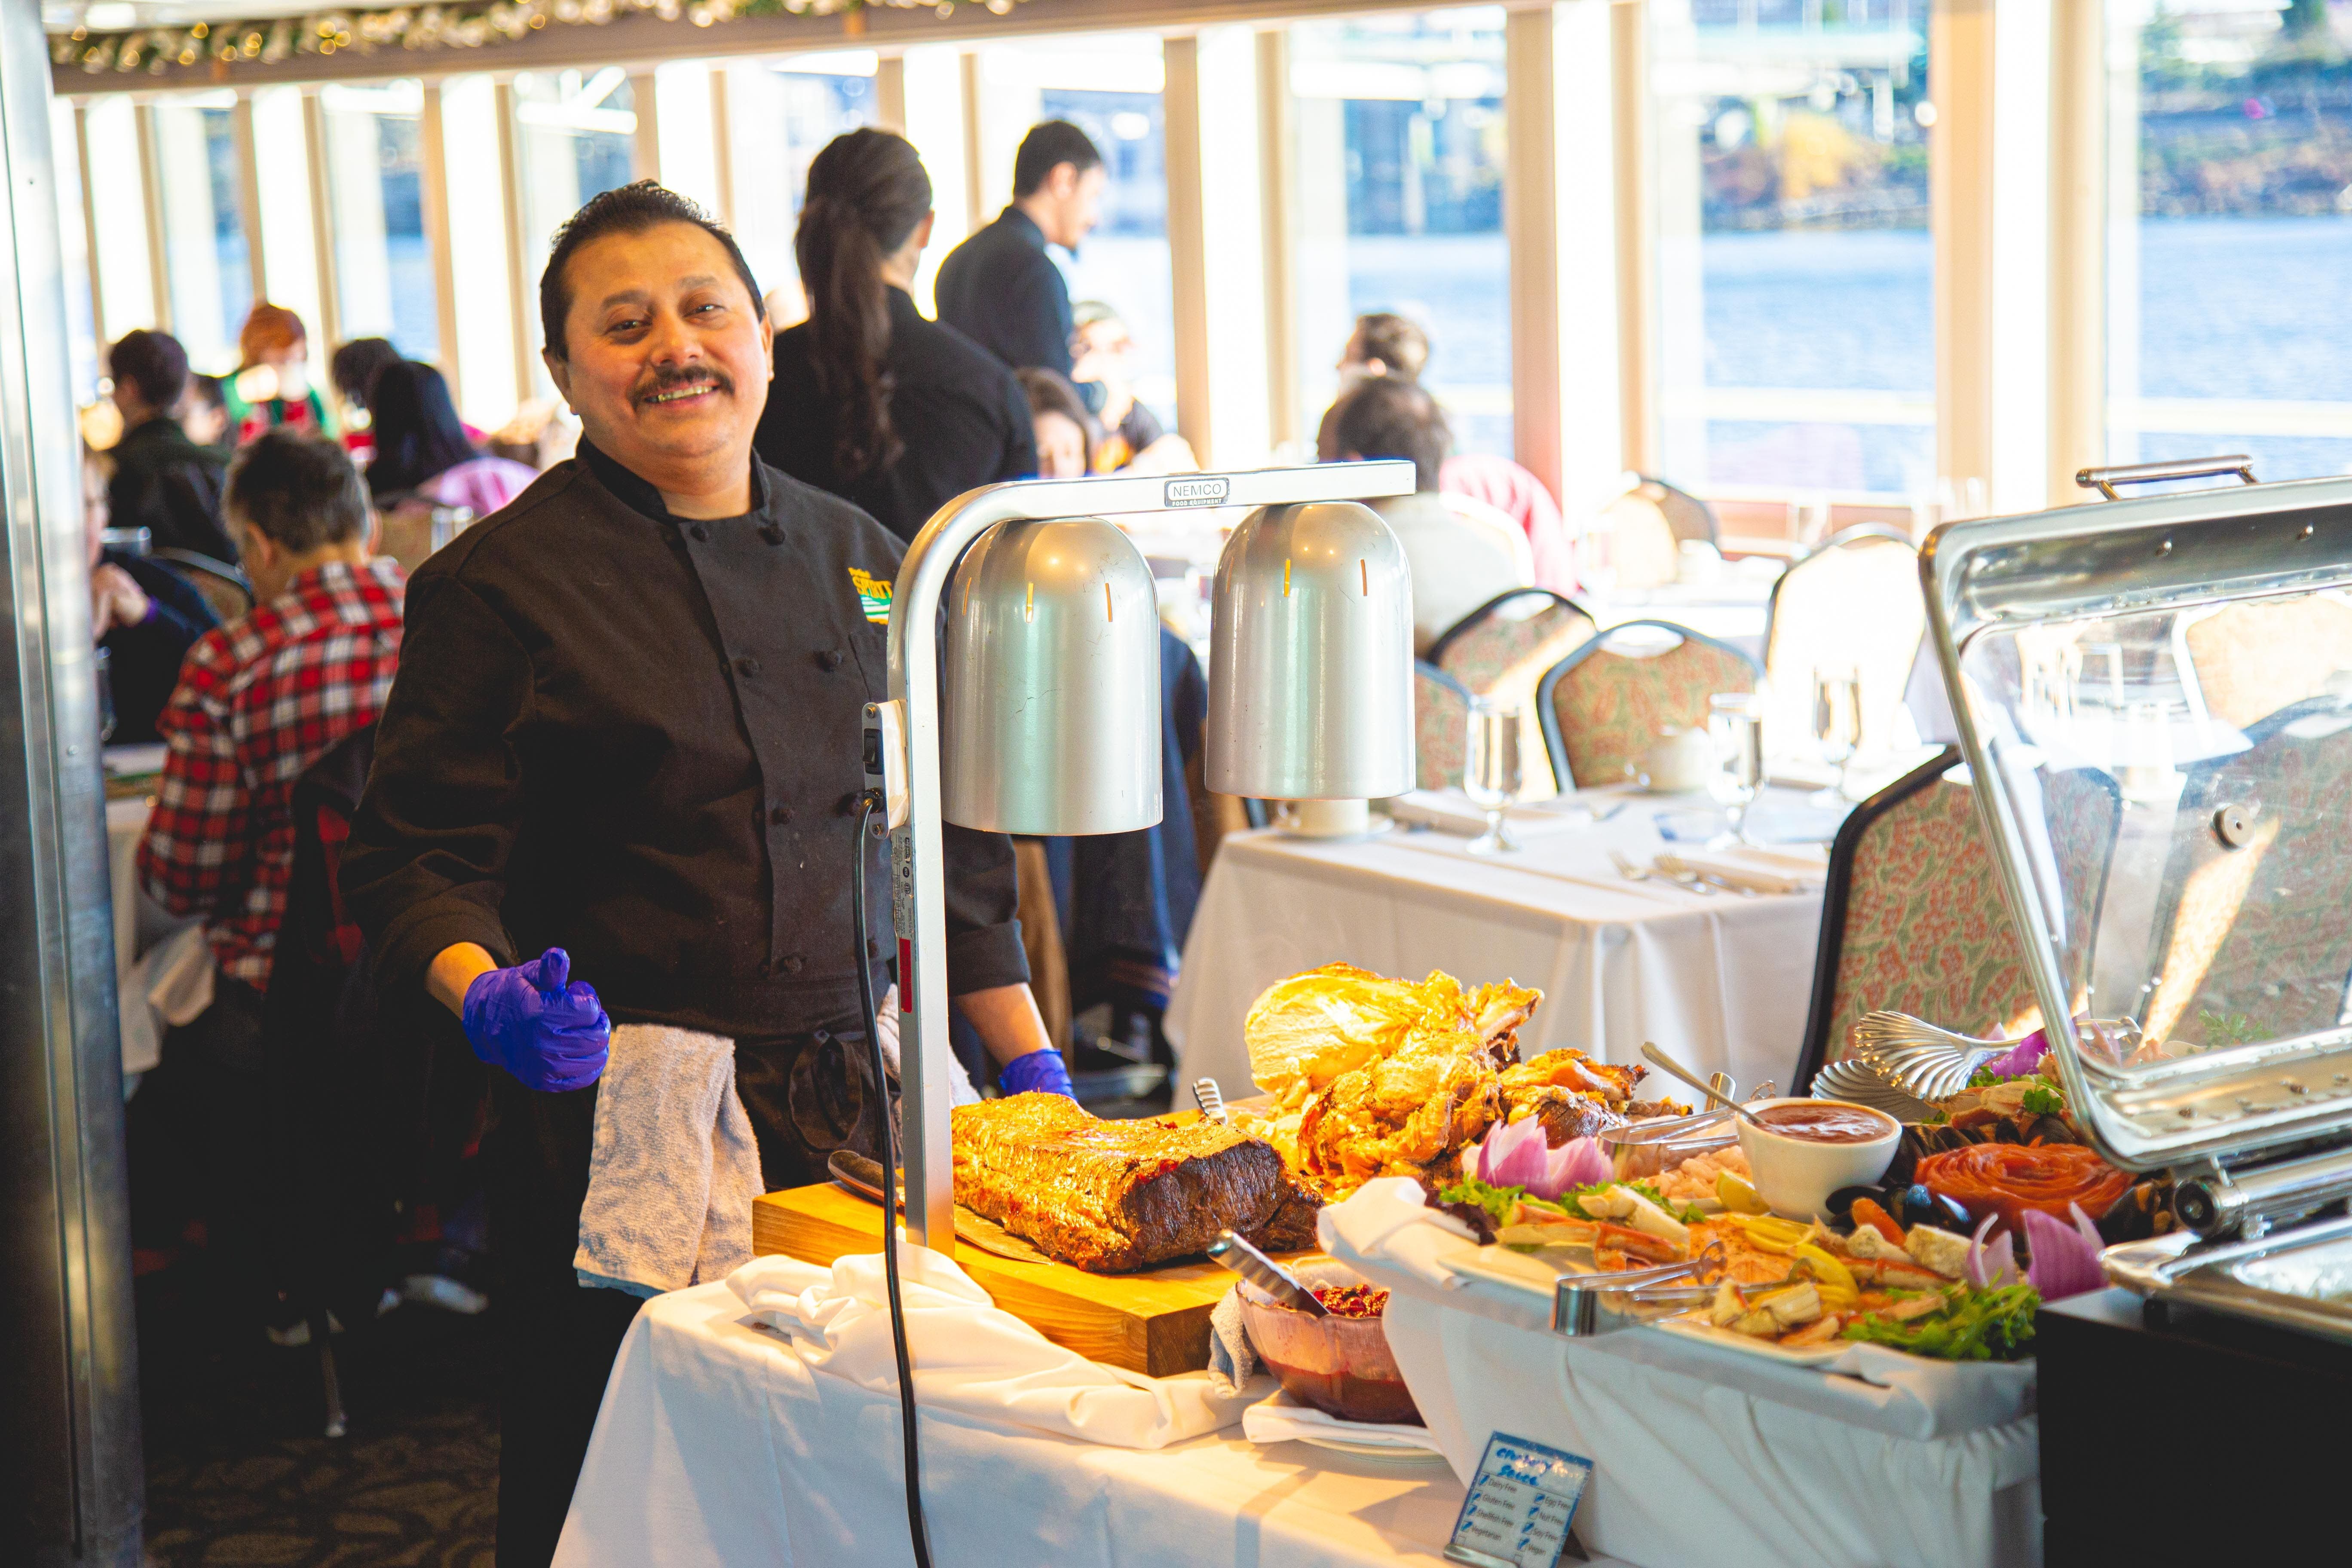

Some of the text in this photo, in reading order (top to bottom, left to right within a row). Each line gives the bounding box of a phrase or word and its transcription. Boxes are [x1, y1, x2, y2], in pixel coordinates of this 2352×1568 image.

[1173, 484, 1221, 497] NEMCO
[1489, 1478, 1518, 1493] Dairy Free
[1482, 1494, 1516, 1510] Gluten Free
[1545, 1496, 1571, 1510] Egg Free
[1477, 1508, 1515, 1528] Shellfish Free
[1539, 1512, 1564, 1525] Nut Free
[1471, 1525, 1502, 1542] Vegetarian
[1533, 1528, 1559, 1542] Soy Free
[1528, 1544, 1547, 1556] Vegan
